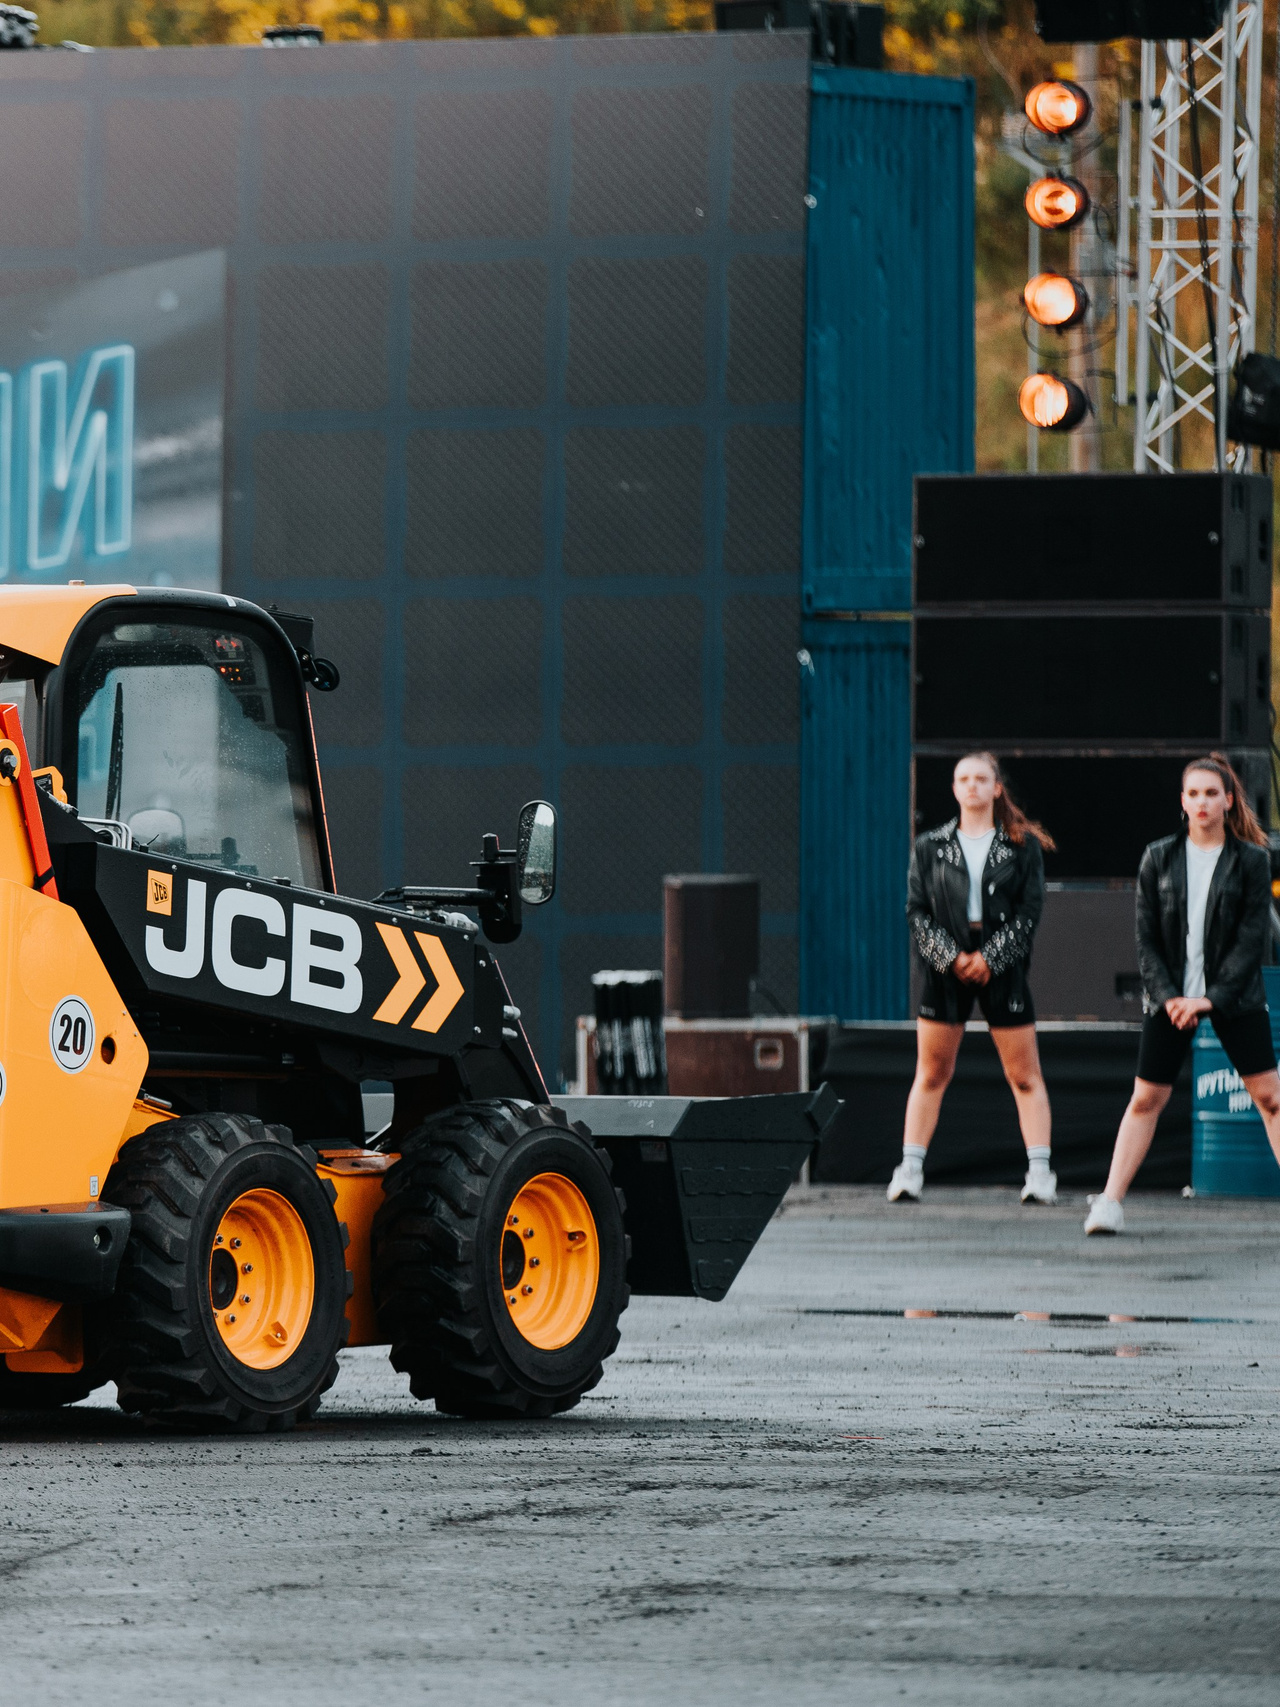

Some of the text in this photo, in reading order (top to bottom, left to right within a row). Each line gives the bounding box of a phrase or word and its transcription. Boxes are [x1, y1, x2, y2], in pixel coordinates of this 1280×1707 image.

[154, 882, 168, 902] JCB
[145, 878, 363, 1014] JCB
[58, 1014, 87, 1055] 20
